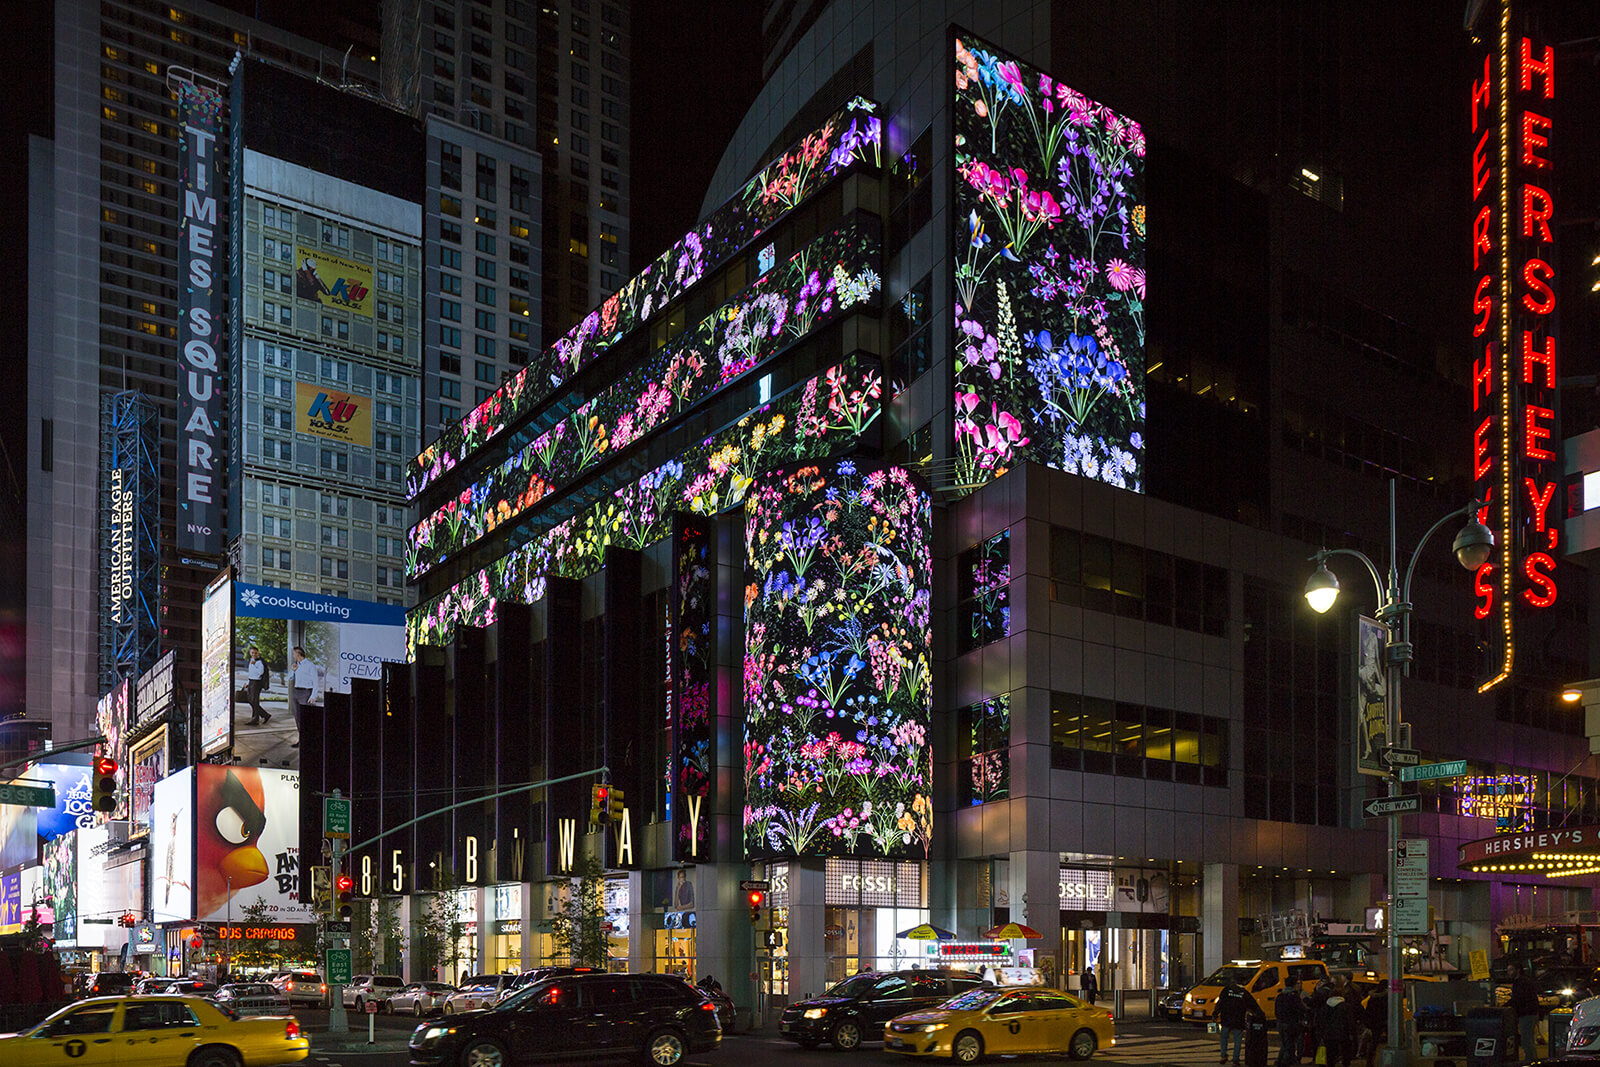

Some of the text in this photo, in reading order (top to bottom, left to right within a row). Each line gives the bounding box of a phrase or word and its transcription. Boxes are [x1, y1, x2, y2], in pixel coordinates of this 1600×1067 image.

[184, 125, 218, 504] TIMES SQUARE
[1520, 36, 1557, 608] HERSHEY'S
[1472, 53, 1492, 619] HERSHEYS
[307, 391, 358, 424] KTU
[187, 523, 212, 536] NYC
[111, 468, 122, 624] AMERICAN EAGLE
[122, 490, 133, 600] OUTFITTERS
[262, 594, 351, 619] coolsculpting
[1416, 762, 1465, 779] BROADWAY
[1372, 801, 1413, 812] ONE WAY
[1485, 830, 1583, 855] HERSHEY'S
[269, 904, 279, 912] 20
